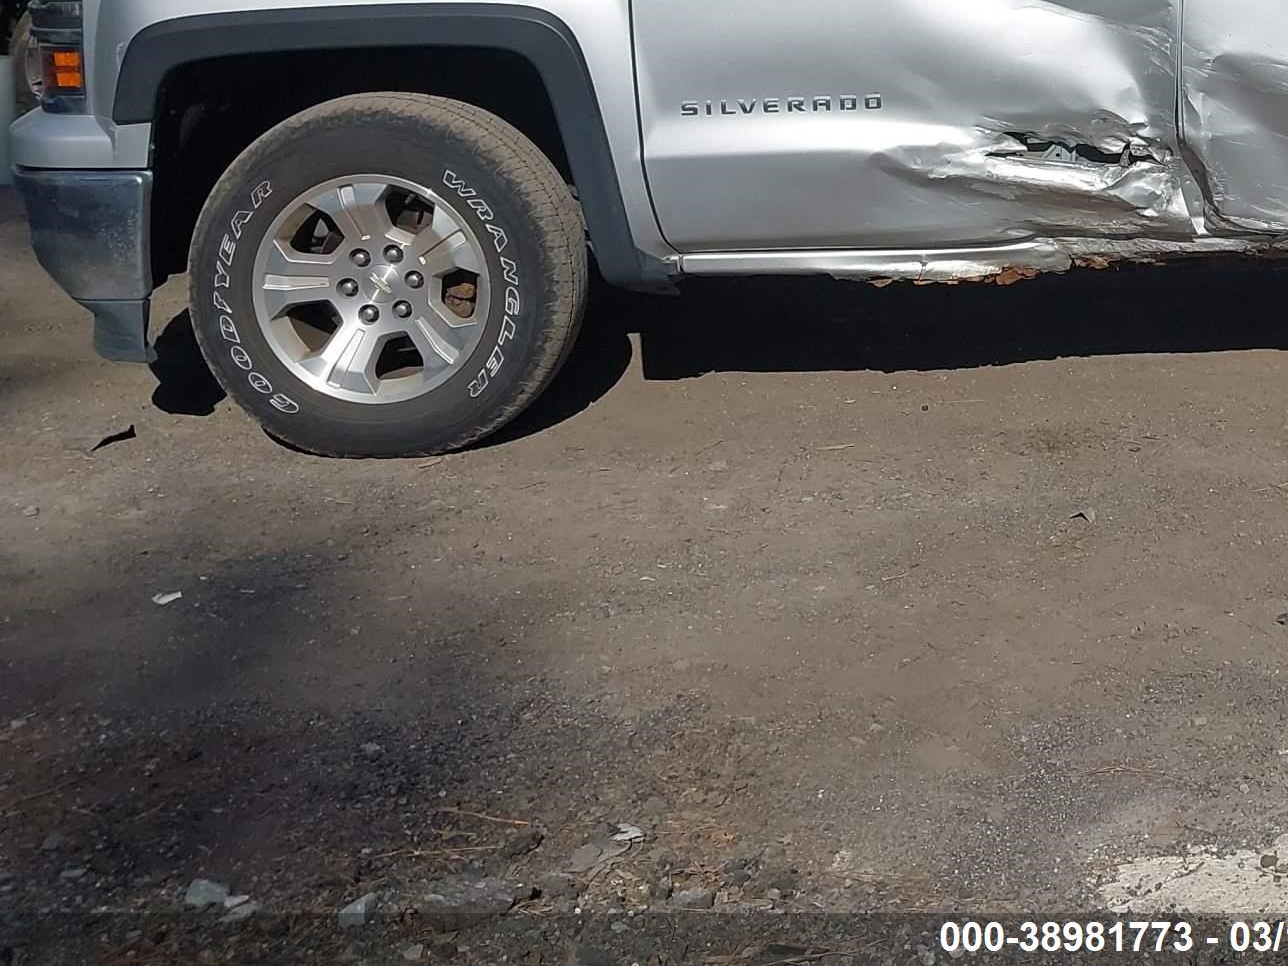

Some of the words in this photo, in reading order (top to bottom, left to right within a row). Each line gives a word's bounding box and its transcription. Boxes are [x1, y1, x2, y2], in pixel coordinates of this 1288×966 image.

[680, 92, 882, 116] SILVERADO
[213, 179, 301, 415] GOODYEAR
[442, 169, 521, 399] WRANGLER
